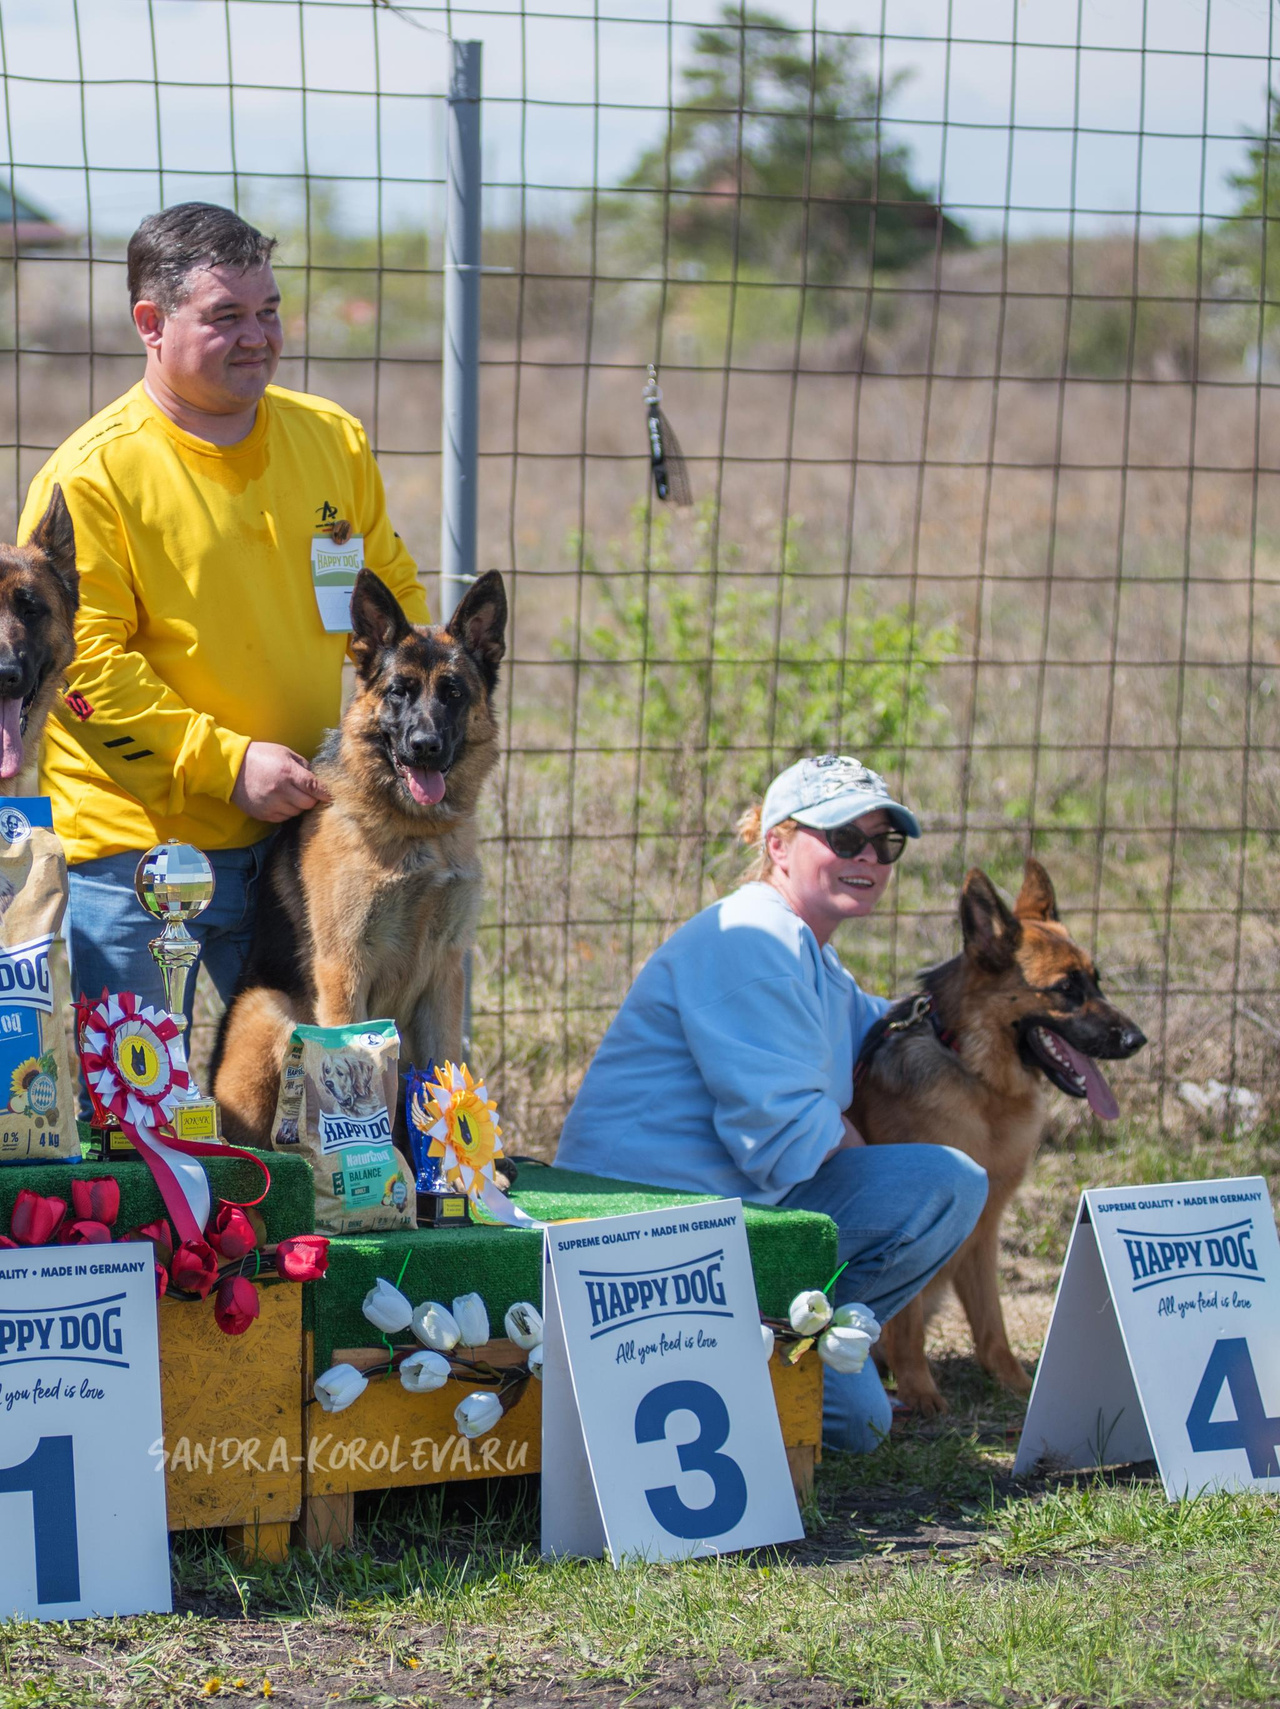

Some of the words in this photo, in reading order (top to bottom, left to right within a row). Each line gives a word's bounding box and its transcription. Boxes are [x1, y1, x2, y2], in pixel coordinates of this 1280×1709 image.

[317, 553, 341, 570] HAPPY
[342, 553, 360, 569] DOG
[3, 1132, 9, 1143] 0
[11, 1132, 19, 1143] %
[39, 1132, 46, 1147] 4
[48, 1132, 60, 1147] kg
[324, 1121, 369, 1143] HAPPY
[368, 1117, 391, 1139] DO
[349, 1168, 382, 1181] BALANCE
[354, 1187, 367, 1195] ADULT
[1098, 1202, 1137, 1213] SUPREME
[1138, 1199, 1174, 1210] QUALITY
[1183, 1197, 1208, 1207] MADE
[1209, 1196, 1219, 1205] IN
[1220, 1193, 1262, 1204] GERMANY
[558, 1236, 601, 1252] SUPREME
[602, 1230, 641, 1245] QUALITY
[651, 1224, 677, 1237] MADE
[679, 1222, 690, 1233] IN
[691, 1216, 737, 1231] GERMANY
[1124, 1238, 1205, 1281] HAPPY
[1208, 1231, 1259, 1271] DOG
[41, 1265, 73, 1278] MADE
[75, 1265, 87, 1276] IN
[89, 1262, 146, 1275] GERMANY
[585, 1277, 668, 1327] HAPPY
[672, 1263, 727, 1306] DOG
[1157, 1297, 1179, 1317] All
[1178, 1300, 1197, 1318] you
[1196, 1292, 1218, 1313] feed
[1220, 1297, 1230, 1309] is
[1232, 1291, 1252, 1310] love
[59, 1307, 123, 1355] DOG
[615, 1342, 637, 1365] All
[638, 1344, 658, 1365] you
[660, 1331, 682, 1355] feed
[684, 1336, 694, 1350] is
[697, 1329, 718, 1349] love
[6, 1388, 31, 1411] you
[32, 1378, 62, 1402] feed
[64, 1384, 77, 1399] is
[79, 1378, 105, 1400] love
[1186, 1337, 1280, 1479] 4
[635, 1380, 748, 1540] 3
